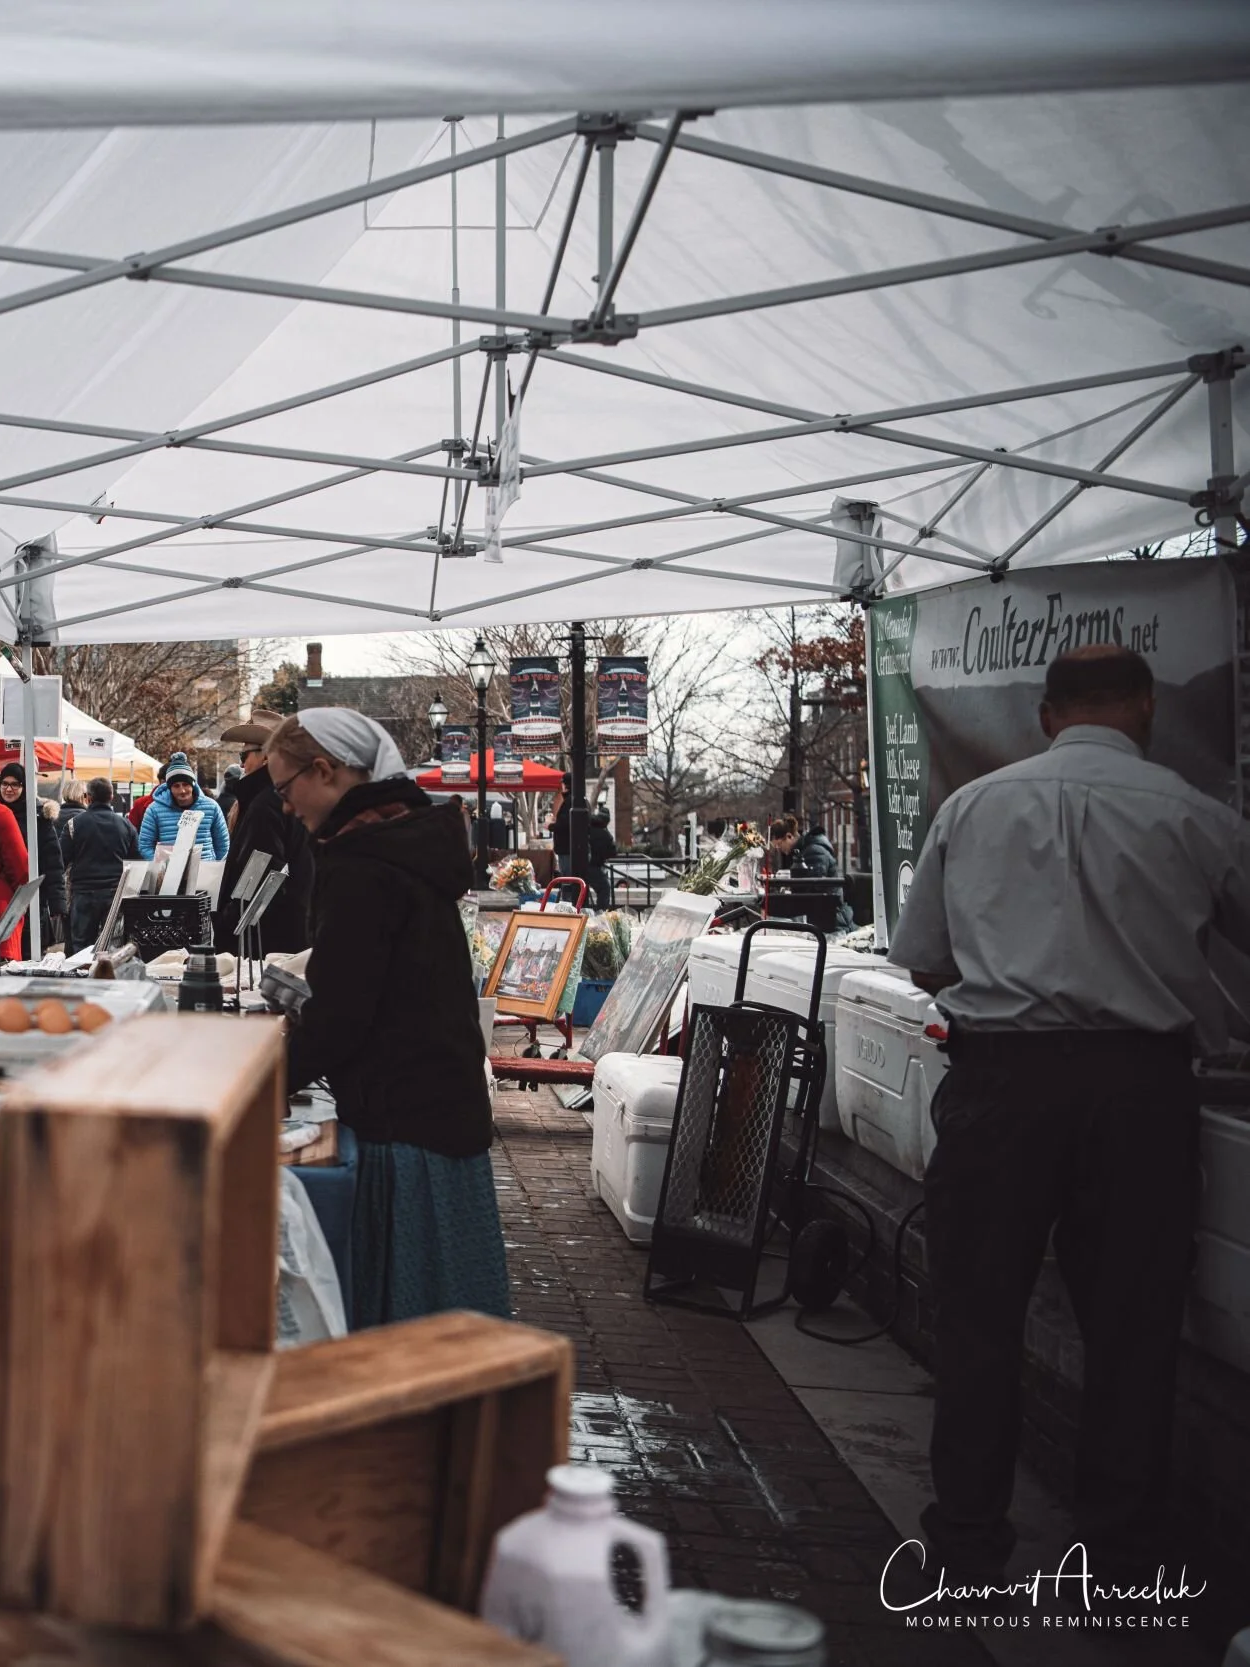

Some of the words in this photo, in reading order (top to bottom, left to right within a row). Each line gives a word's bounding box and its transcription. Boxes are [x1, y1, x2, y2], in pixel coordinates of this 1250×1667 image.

[899, 712, 918, 744] Lamb
[899, 748, 920, 780] Cheese
[901, 785, 920, 827] Yogurt
[896, 819, 913, 851] Butter
[857, 1033, 886, 1068] IGLOO
